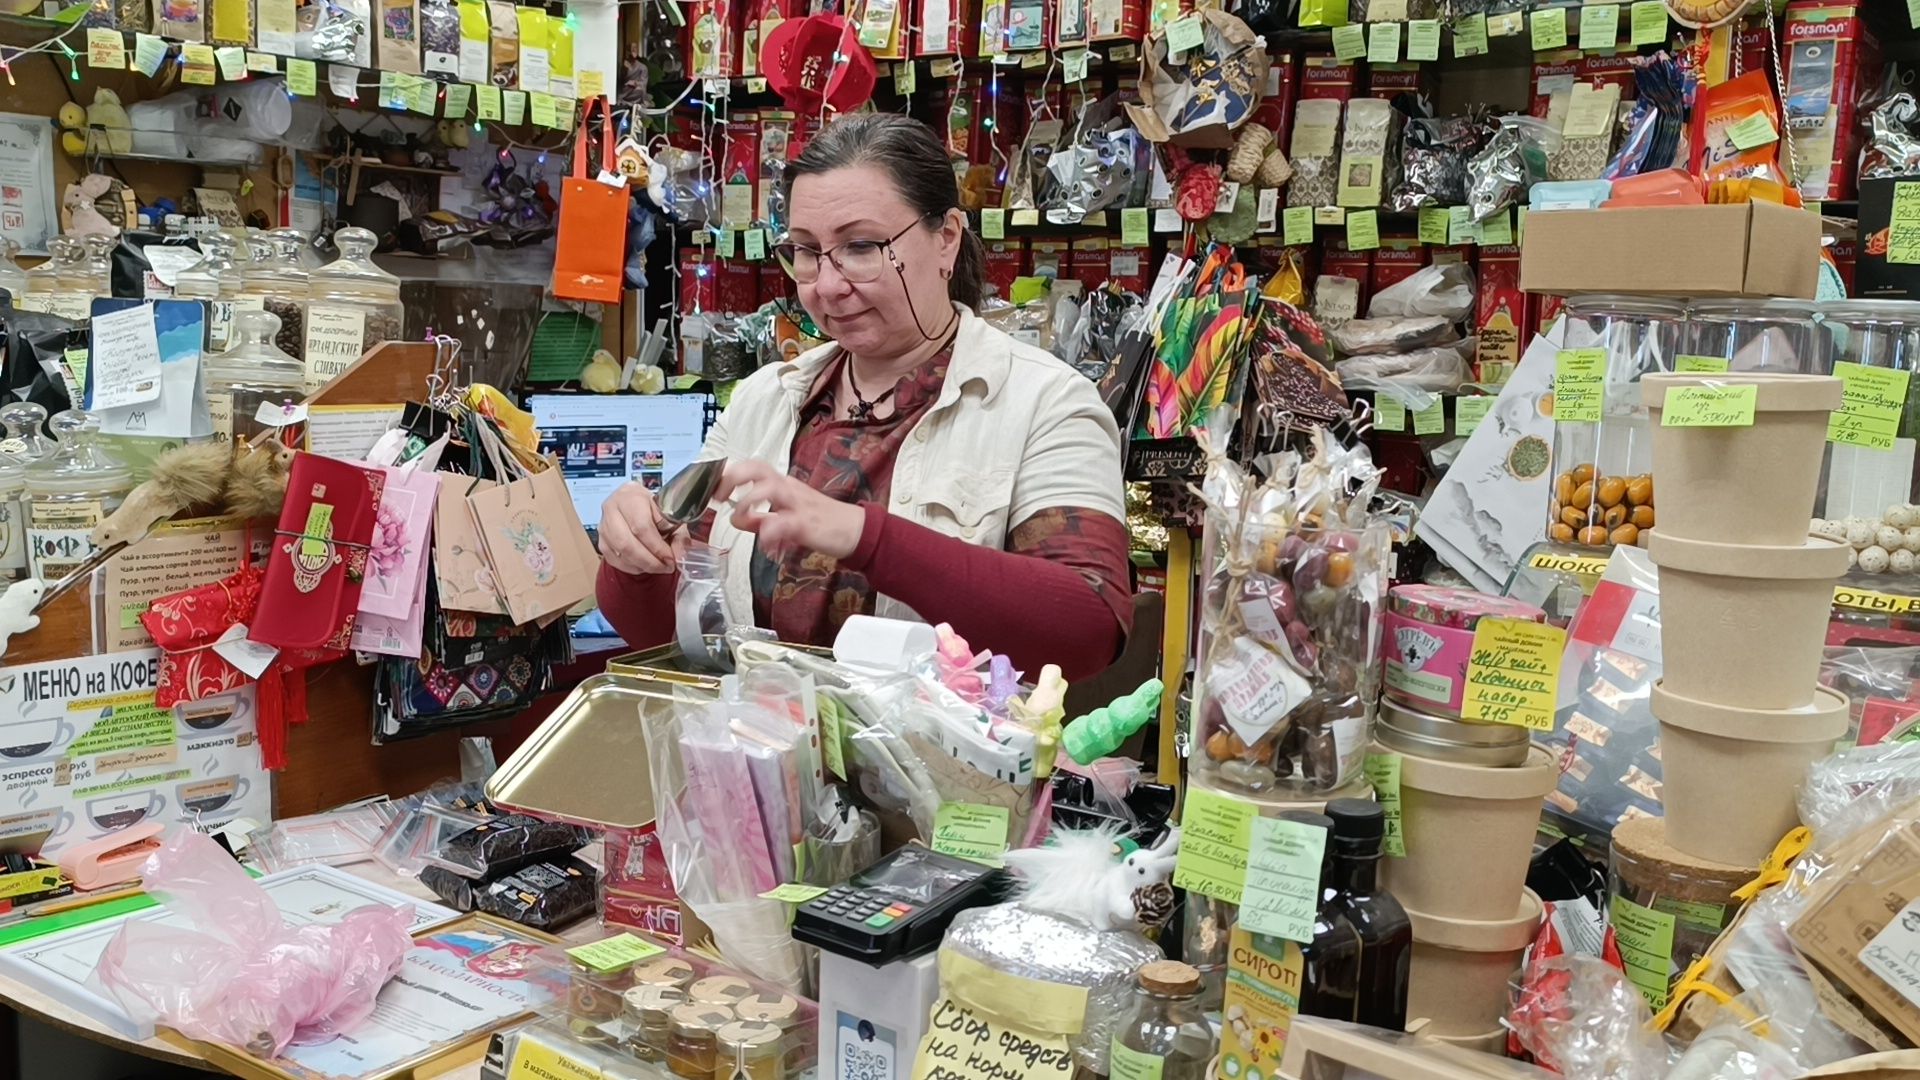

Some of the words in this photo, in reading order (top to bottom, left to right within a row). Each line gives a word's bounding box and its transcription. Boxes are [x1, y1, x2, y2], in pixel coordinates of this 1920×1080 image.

[1790, 22, 1844, 36] forsman
[1306, 67, 1347, 80] forsman
[1535, 64, 1577, 75] forsman
[1377, 250, 1416, 260] forsman
[1483, 246, 1519, 255] forsma
[1870, 436, 1891, 448] РУБ
[204, 533, 221, 543] ЧАЙ
[141, 549, 189, 560] ассортименте
[120, 565, 134, 573] Чай
[23, 666, 81, 702] МЕНЮ
[86, 671, 106, 695] на
[111, 658, 158, 692] КОФЕ
[1480, 704, 1511, 721] 715
[1524, 713, 1549, 728] РУБ
[187, 738, 235, 752] маккиато
[2, 767, 53, 782] эспрессо
[69, 760, 87, 774] руб
[6, 777, 48, 791] двойной
[74, 769, 92, 782] руб
[1288, 922, 1310, 938] РУБ
[1233, 946, 1297, 988] СИРОП
[406, 954, 526, 1004] БЛАГОДАРНОСТЬ
[933, 999, 991, 1046] Сбор
[999, 1031, 1073, 1071] средств
[926, 1036, 959, 1060] на
[523, 1059, 531, 1070] В
